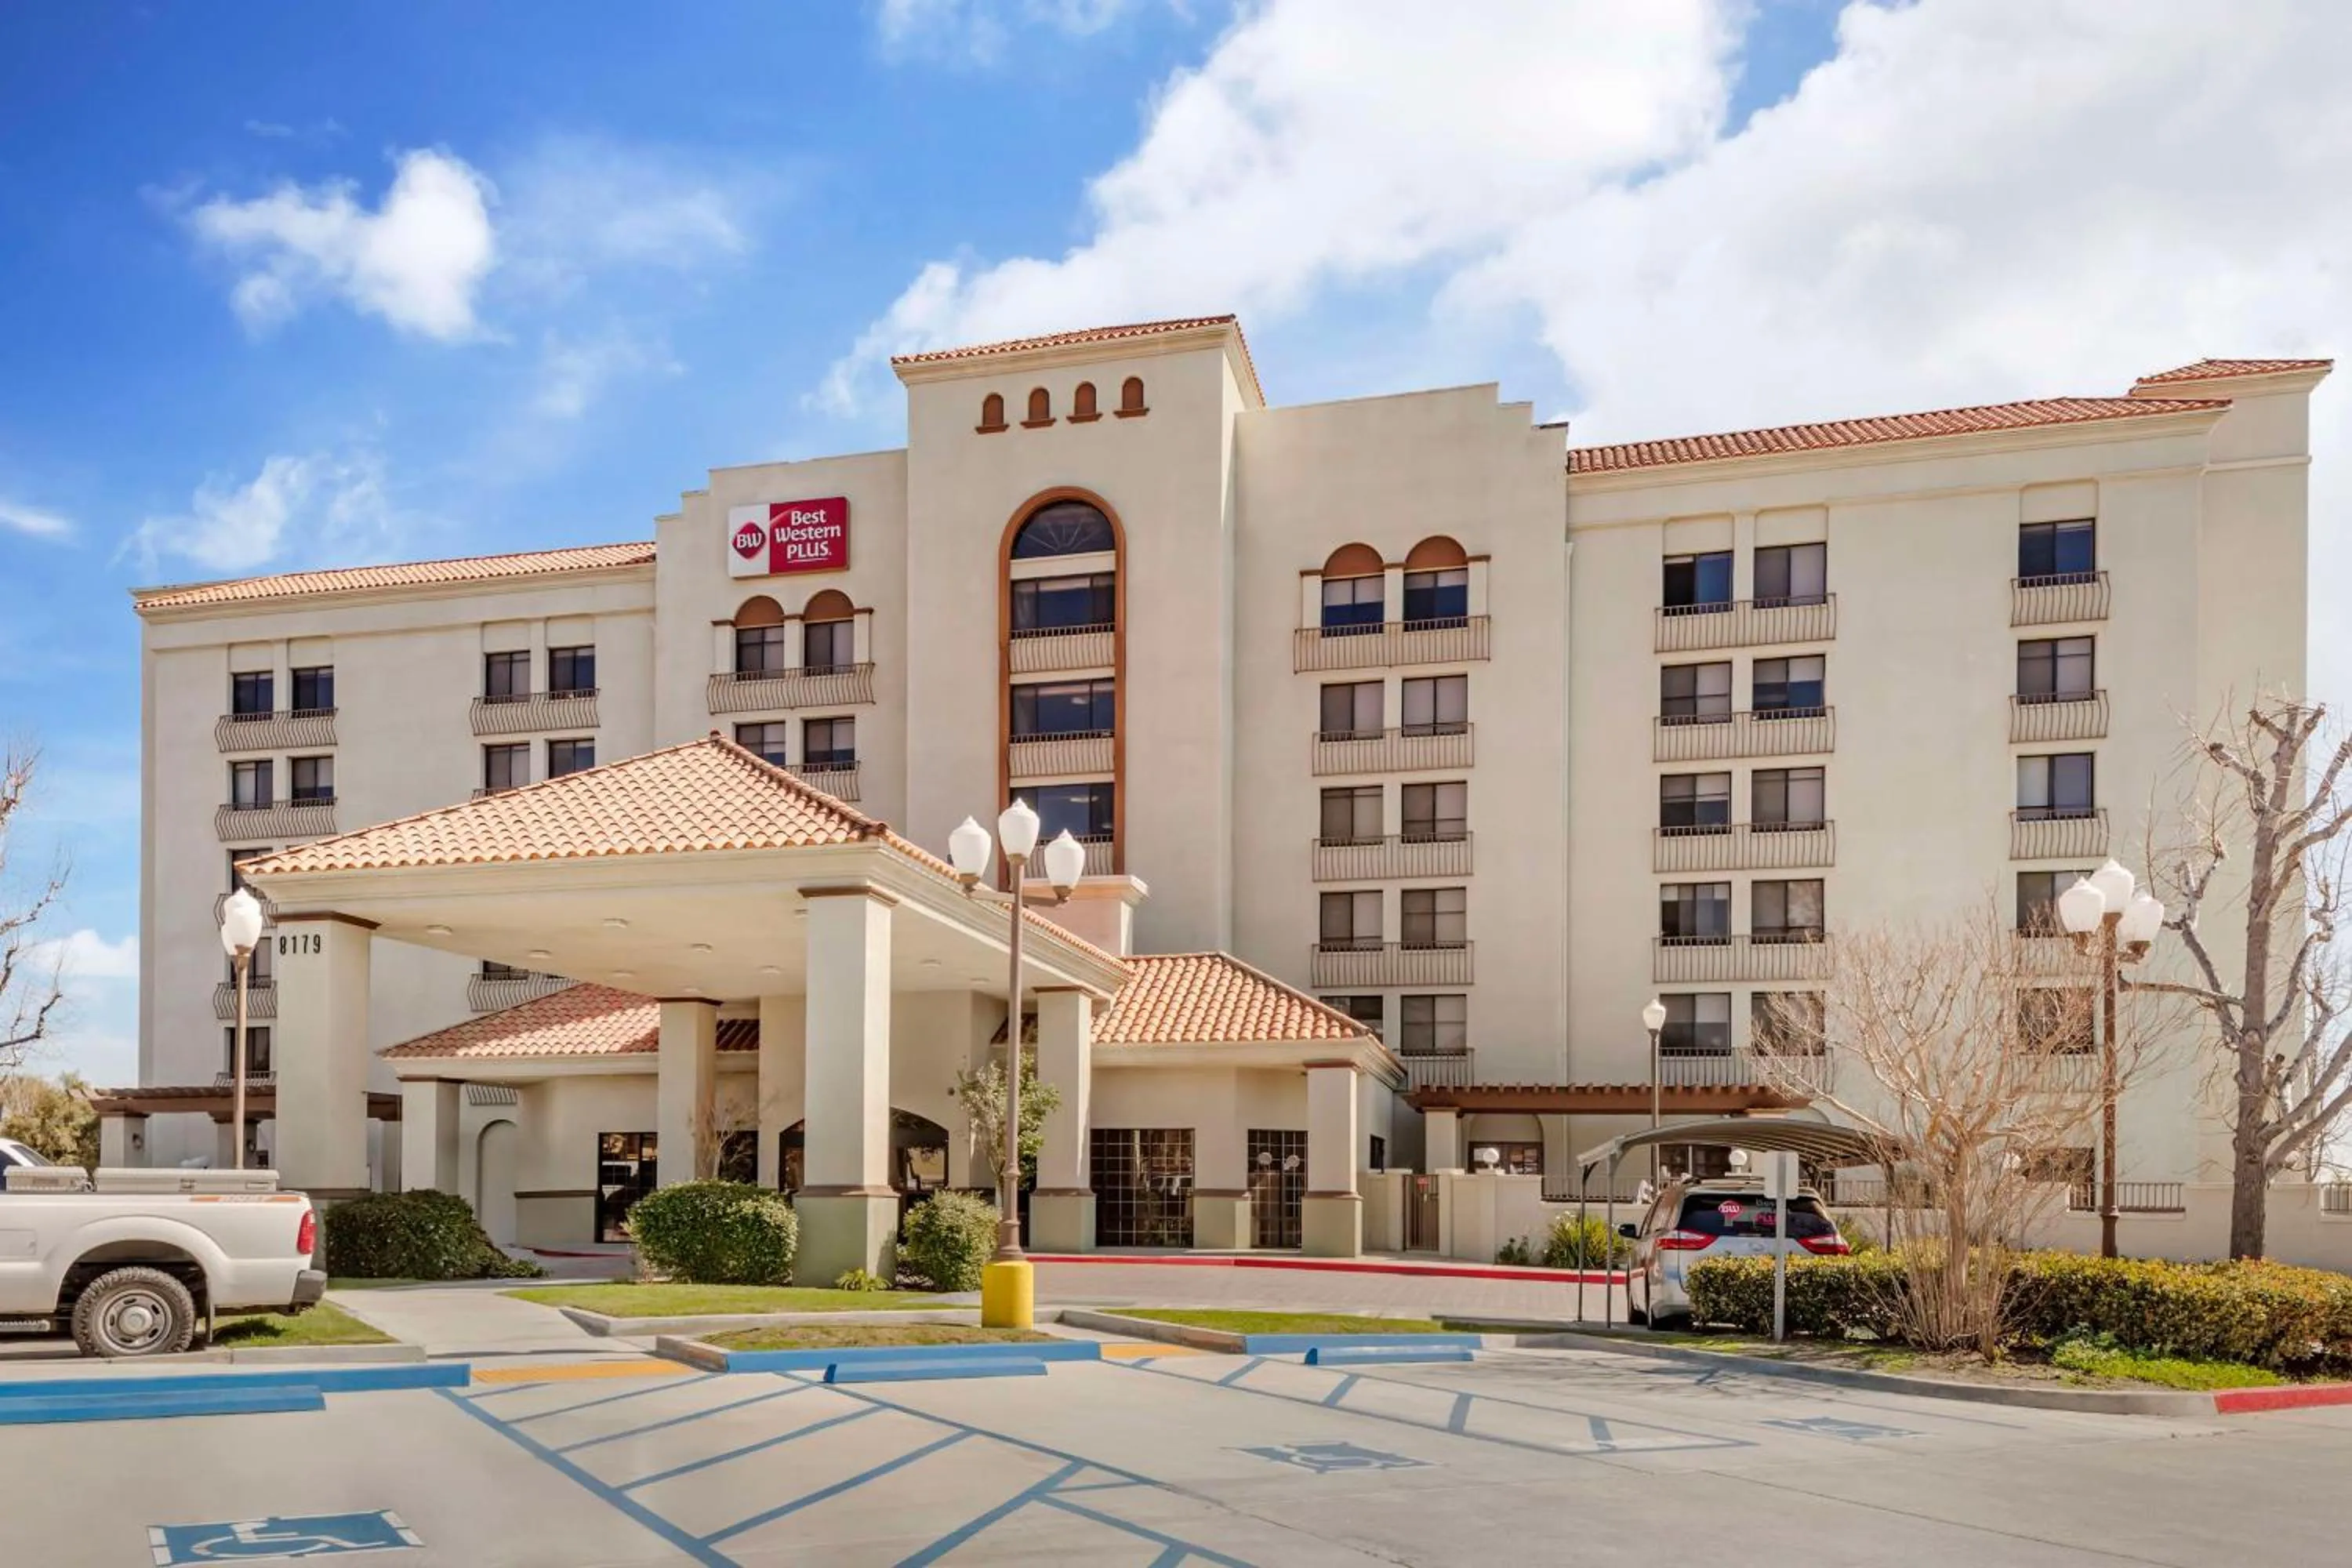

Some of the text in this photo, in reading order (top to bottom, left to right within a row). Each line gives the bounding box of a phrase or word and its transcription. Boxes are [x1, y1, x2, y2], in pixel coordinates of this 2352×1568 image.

[791, 510, 826, 526] Best
[737, 533, 762, 549] BW
[775, 524, 840, 543] Western
[786, 541, 829, 559] PLUS
[280, 934, 321, 956] 8179
